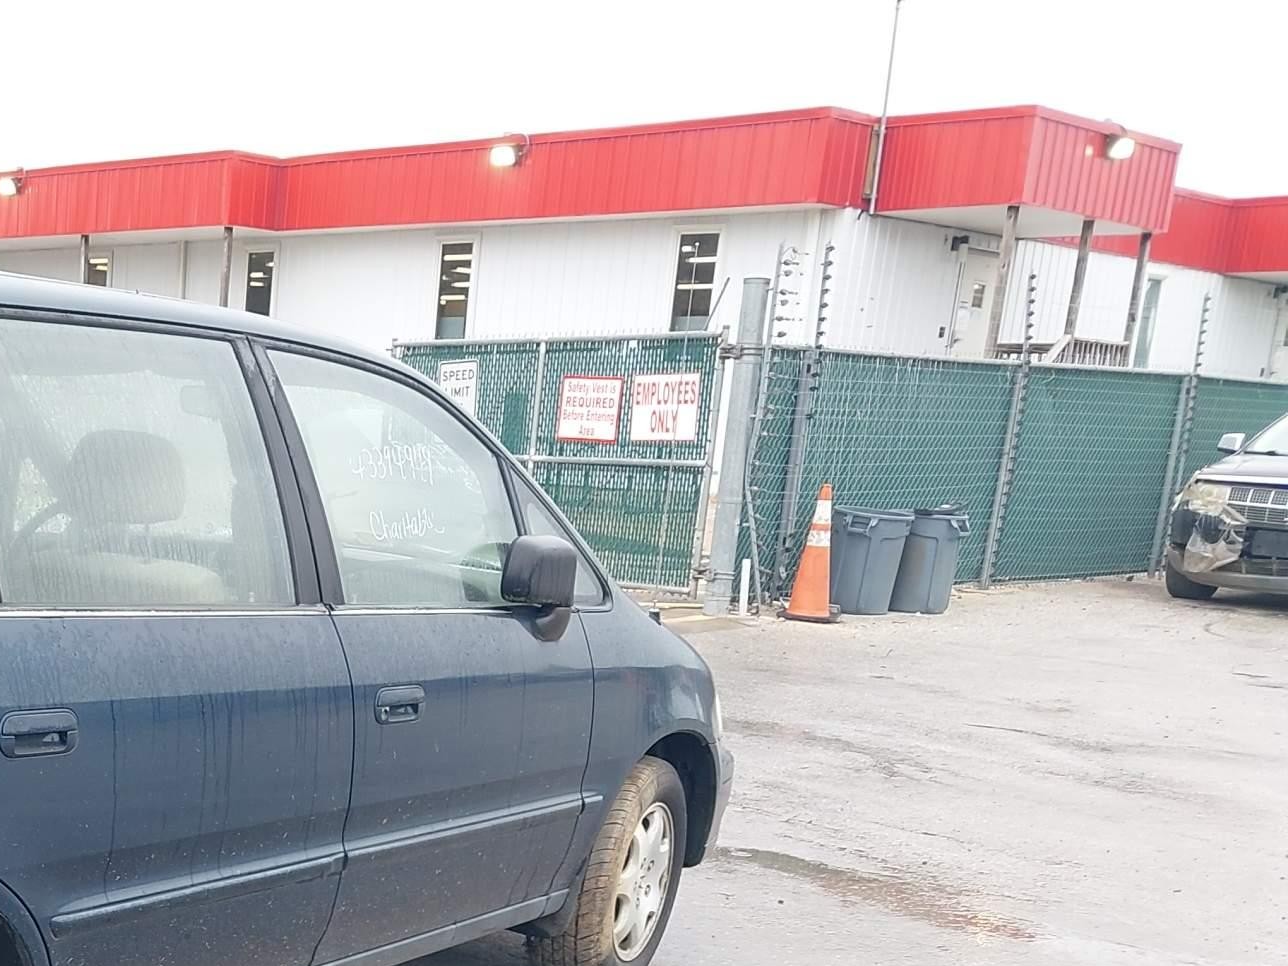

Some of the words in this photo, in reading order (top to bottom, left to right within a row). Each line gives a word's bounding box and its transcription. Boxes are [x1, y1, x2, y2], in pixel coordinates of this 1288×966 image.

[442, 369, 474, 382] SPEED
[567, 381, 589, 396] Safety
[592, 381, 608, 394] Vest
[610, 383, 616, 394] is
[636, 380, 697, 405] EMPLOYEES
[565, 396, 615, 409] REQUIRED
[563, 409, 585, 421] Before
[586, 410, 615, 425] Entering
[650, 409, 678, 433] ONLY
[578, 425, 595, 437] Area
